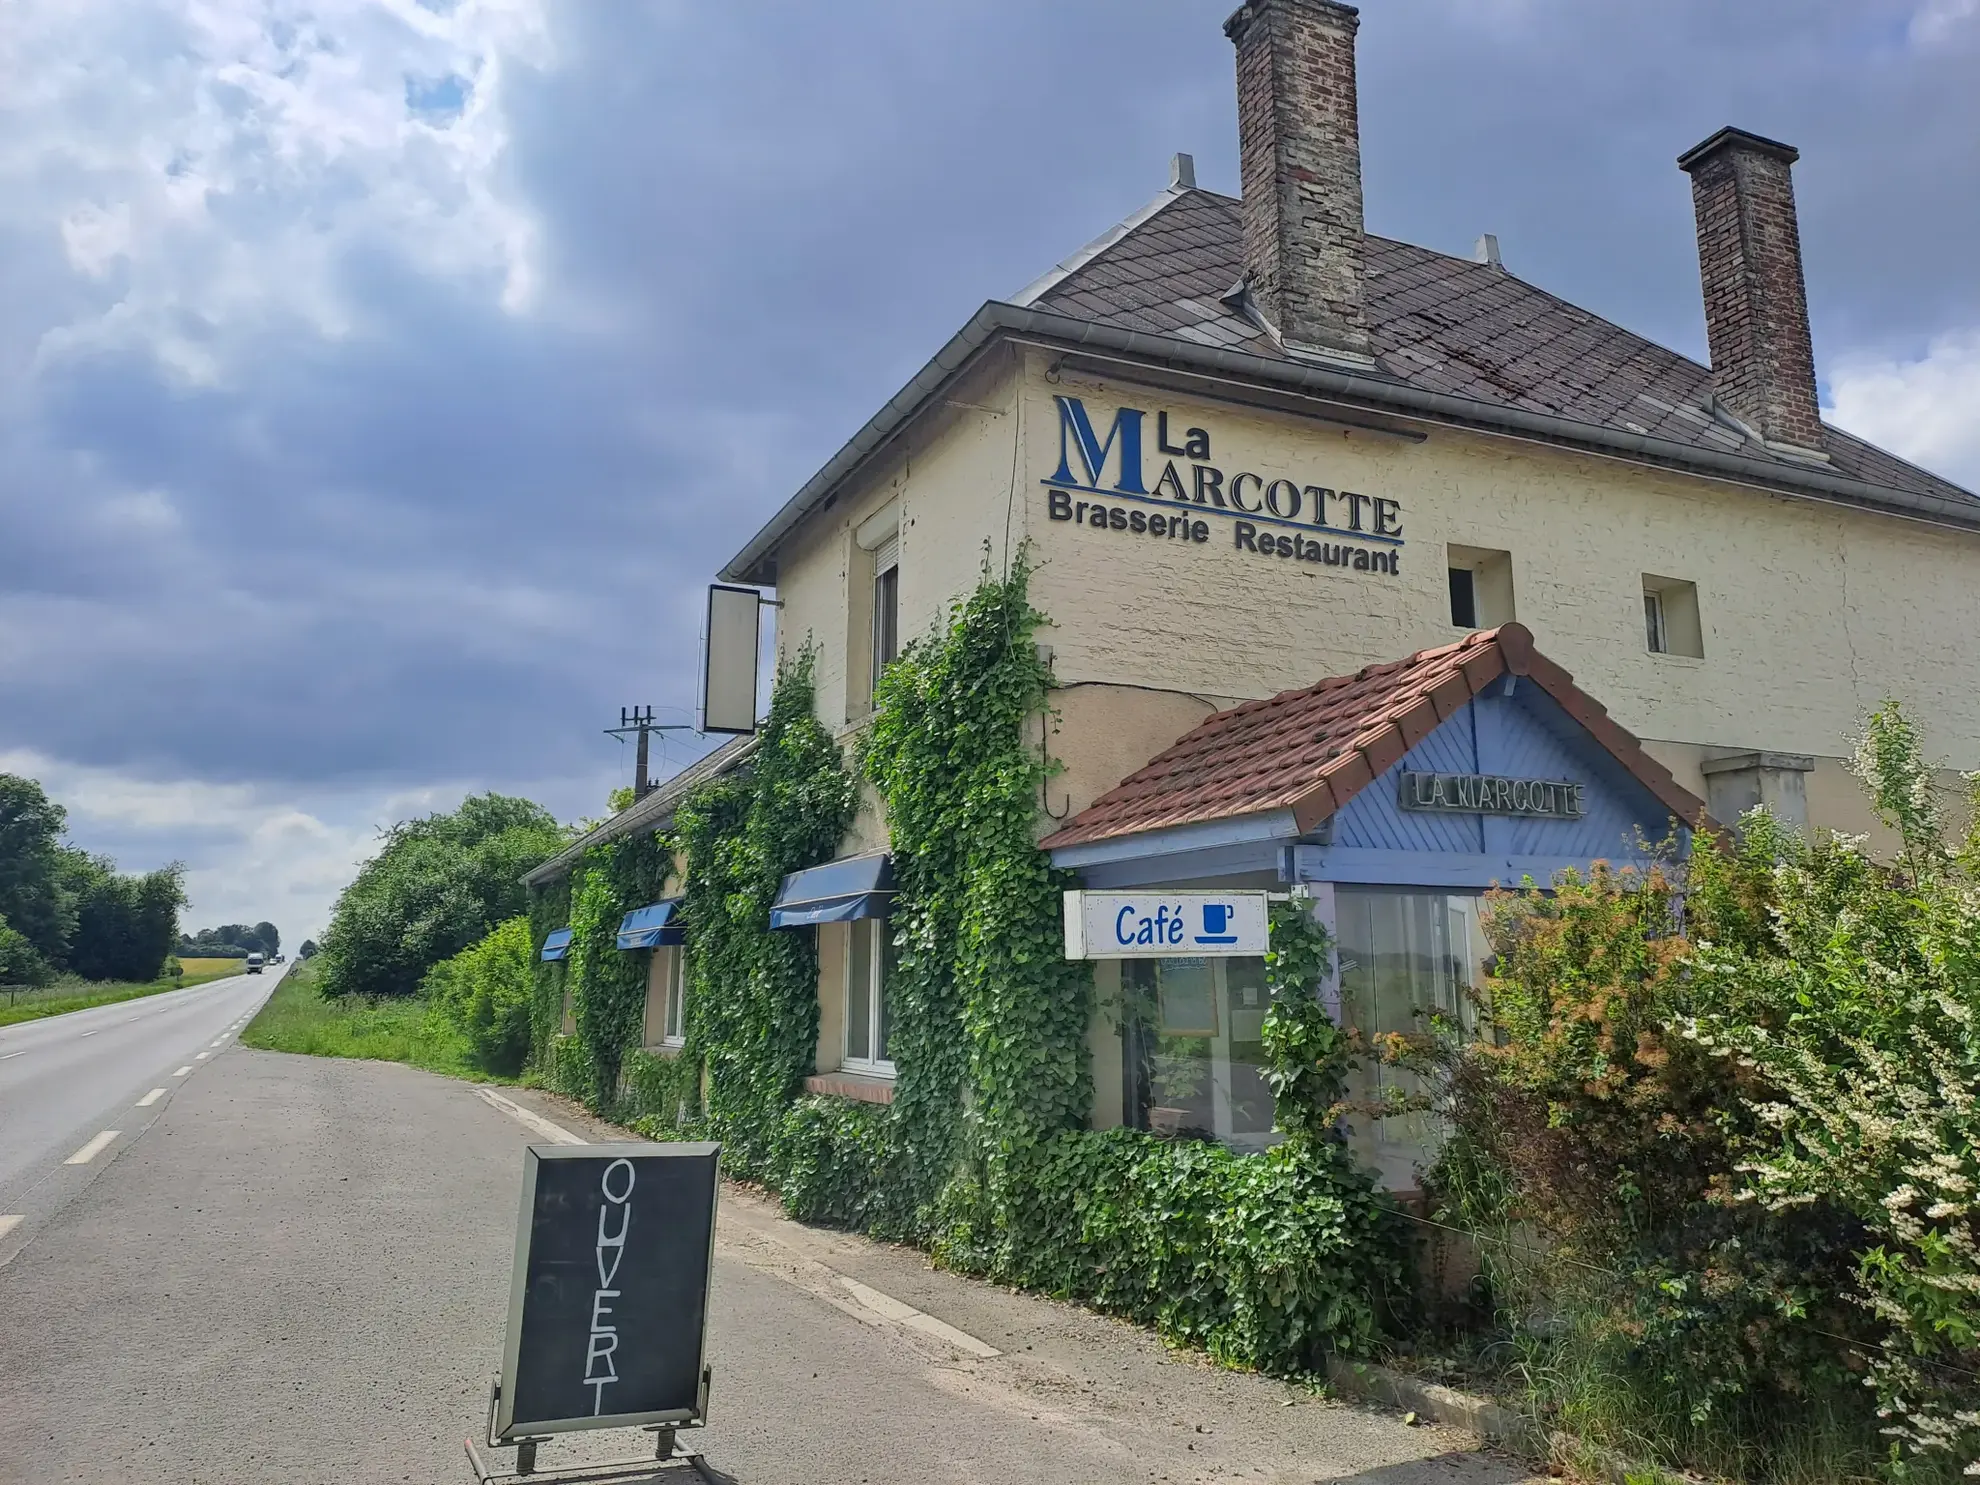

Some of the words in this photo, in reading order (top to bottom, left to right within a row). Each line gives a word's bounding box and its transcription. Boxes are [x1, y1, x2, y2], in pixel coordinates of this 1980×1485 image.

[1050, 394, 1404, 537] MARCOTTE
[1158, 410, 1211, 460] La
[1049, 489, 1209, 543] Brasserie
[1235, 520, 1400, 575] Restaurant
[1414, 772, 1448, 805] LA
[1457, 775, 1588, 815] MARCOTTE
[1115, 904, 1184, 946] Café
[582, 1157, 636, 1416] OUVERT
